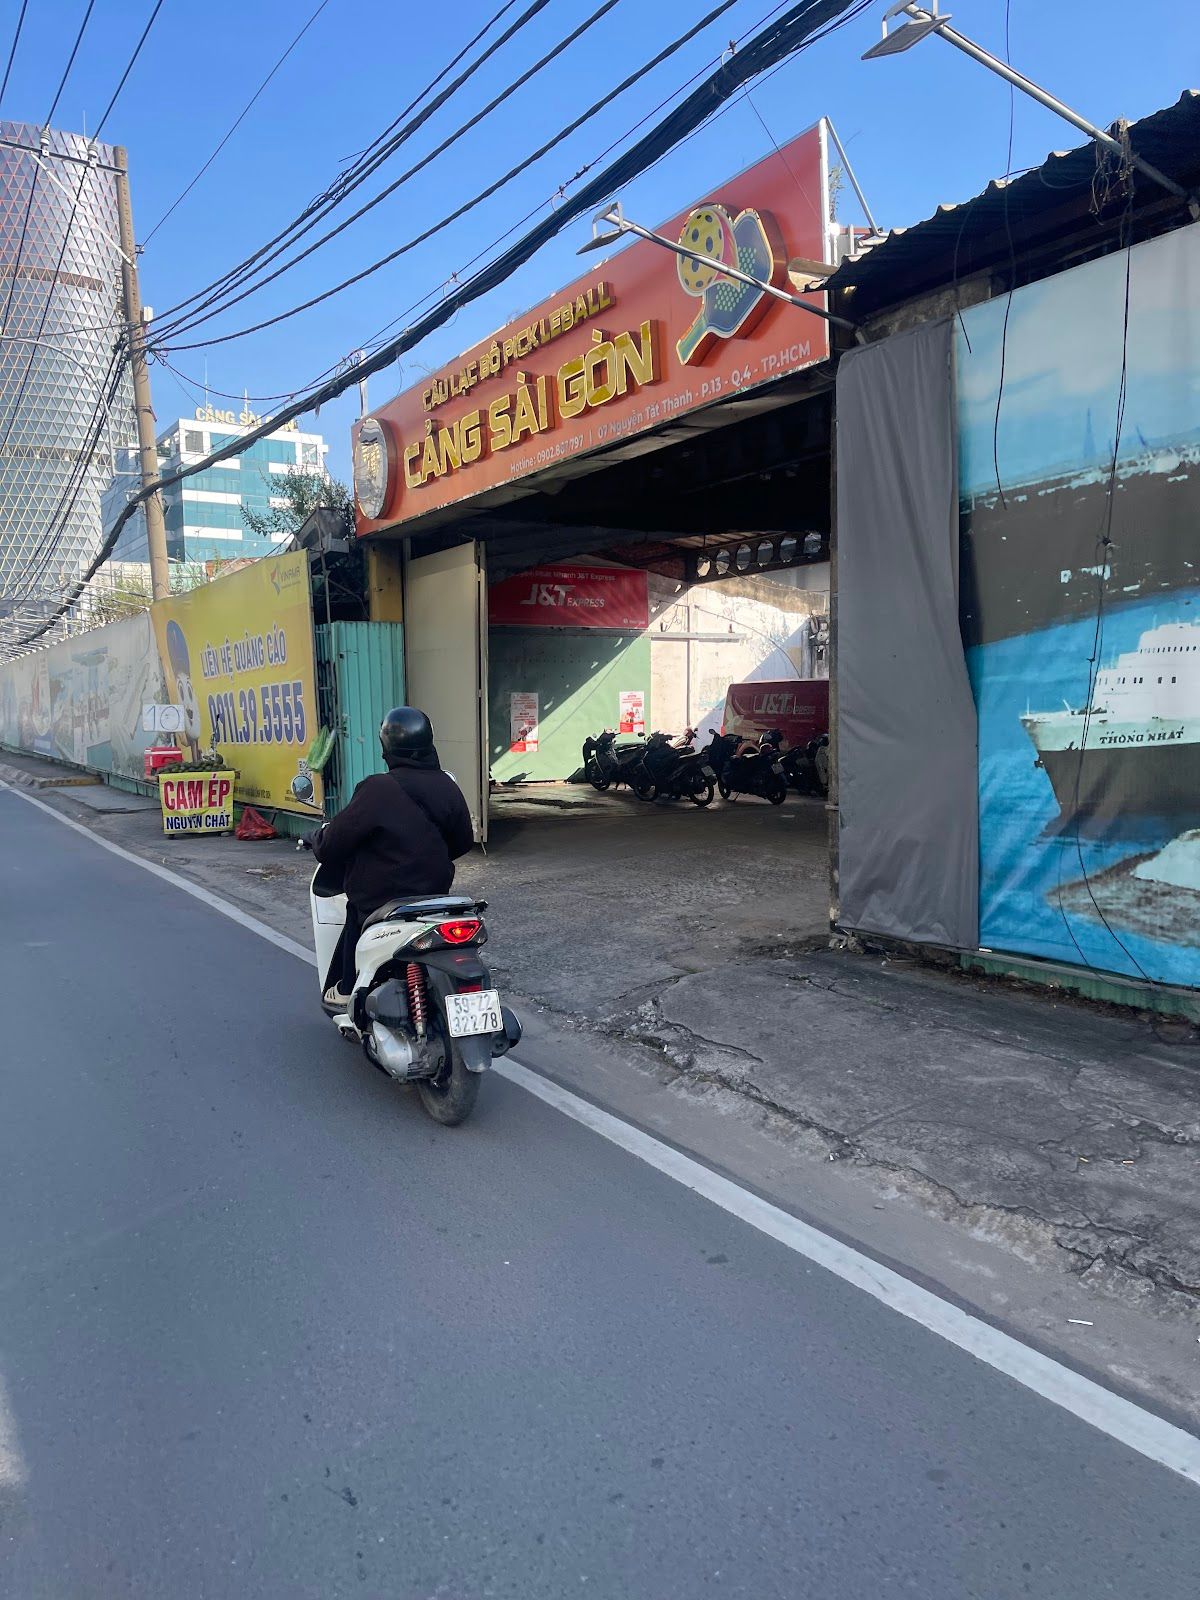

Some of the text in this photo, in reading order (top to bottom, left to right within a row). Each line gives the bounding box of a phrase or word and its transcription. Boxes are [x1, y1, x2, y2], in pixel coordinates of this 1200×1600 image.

[450, 361, 478, 395] LẠC
[480, 340, 501, 380] BỘ
[503, 281, 612, 367] PICKLEBALL
[403, 409, 482, 489] CẢNG
[489, 371, 549, 452] SÀI
[557, 320, 653, 419] GÒN
[510, 456, 537, 474] Hotline:
[598, 424, 609, 438] 07
[661, 390, 693, 413] Thành
[701, 376, 722, 397] P.13
[731, 363, 752, 386] Q.4
[760, 340, 812, 373] TP.HCM
[520, 583, 605, 608] J&T EXPRESS
[201, 623, 286, 681] LIÊN HỆ QUẢNG CÁO
[147, 705, 181, 731] 10
[207, 681, 306, 743] 0911.39.5555
[164, 773, 231, 811] CAM ÉP
[166, 809, 231, 830] NGUYÊN CHẤT
